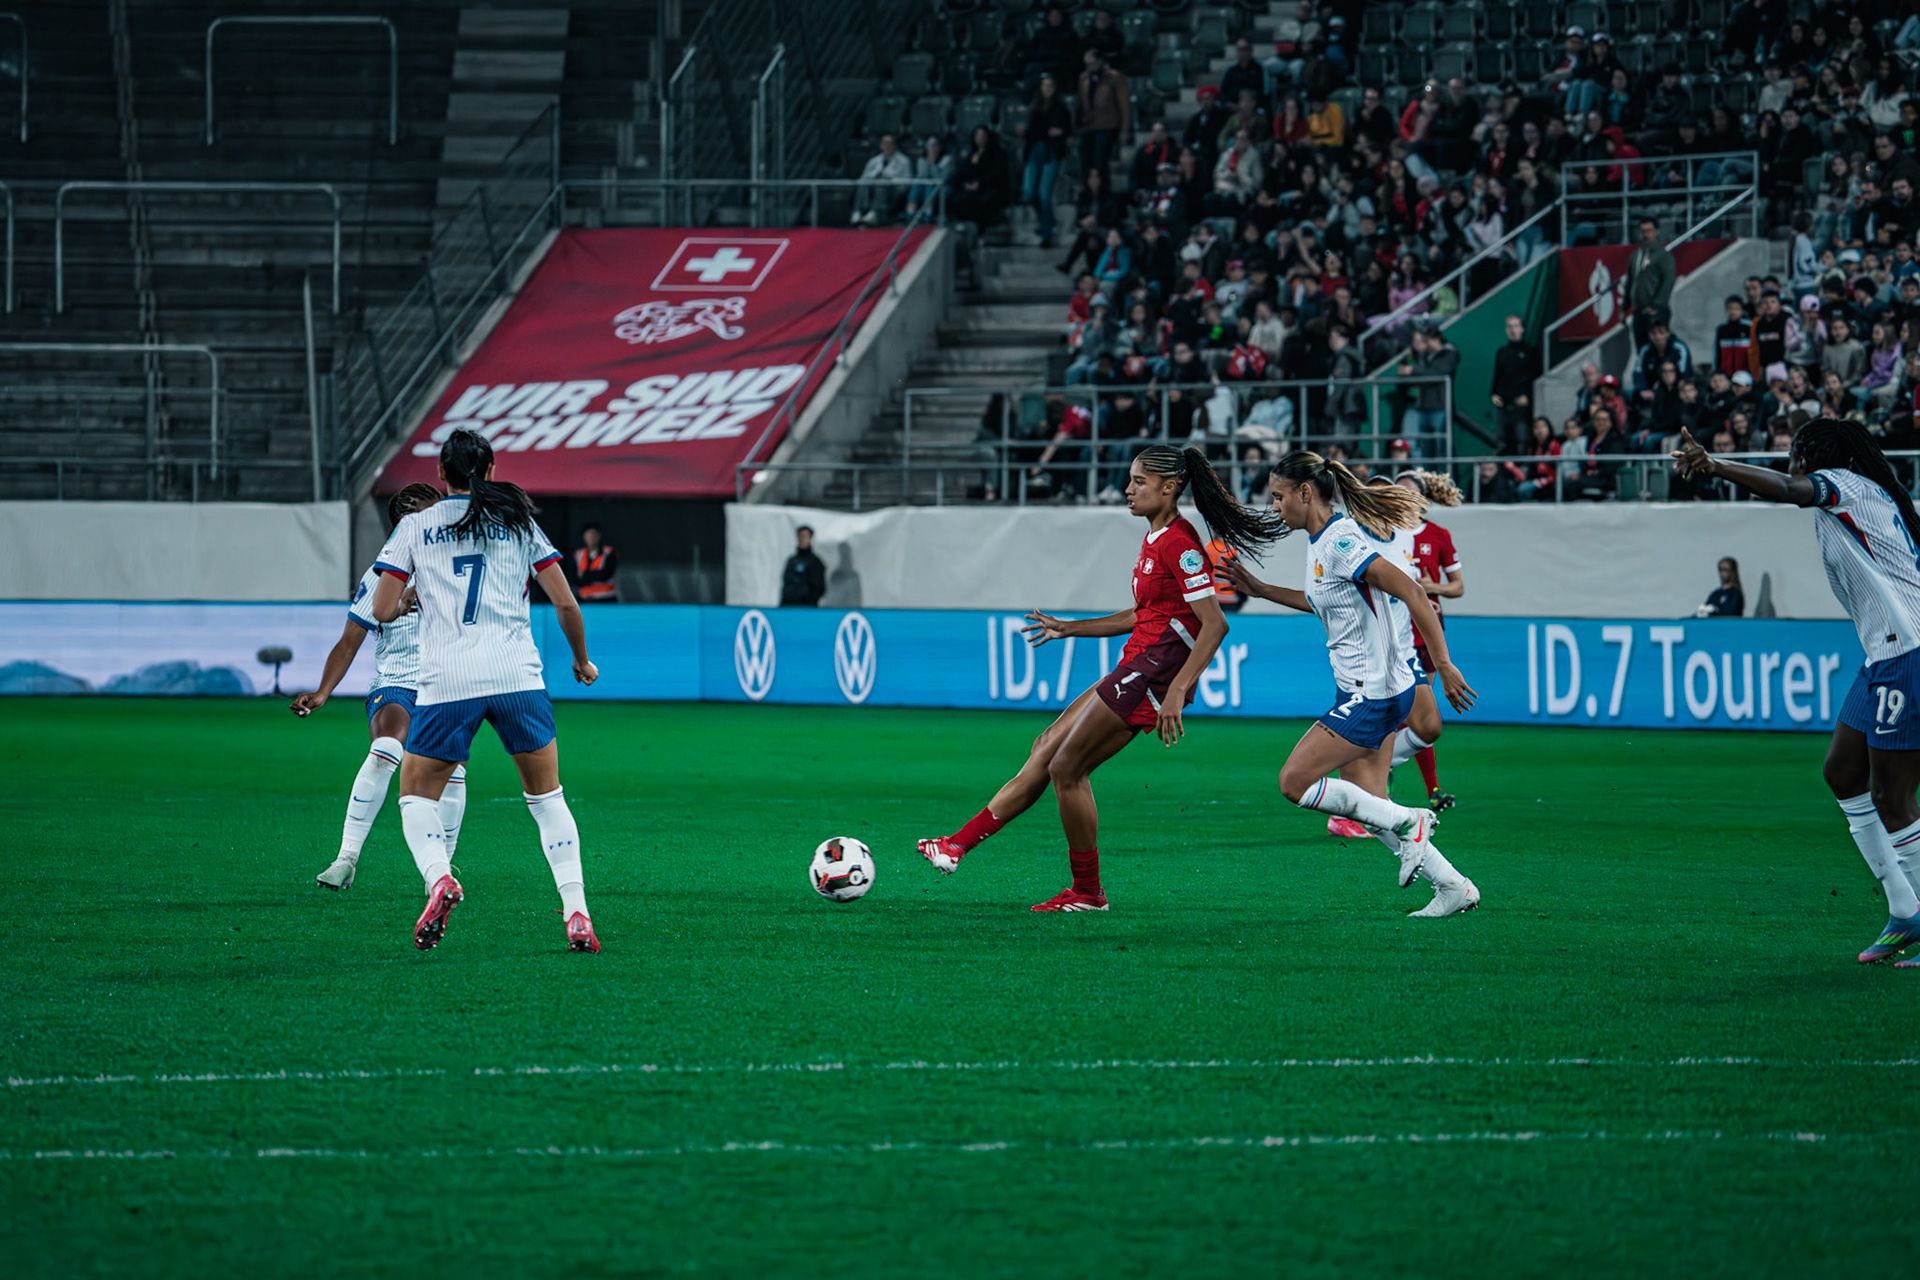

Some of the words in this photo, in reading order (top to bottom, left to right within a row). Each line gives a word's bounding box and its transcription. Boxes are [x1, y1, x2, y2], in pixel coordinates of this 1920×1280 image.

[443, 379, 609, 420] WIR
[608, 364, 806, 413] SIND
[412, 401, 777, 457] SCHWEIZ
[453, 553, 486, 626] 7
[1527, 623, 1633, 718] ID.7
[1650, 625, 1840, 722] Tourer
[1338, 693, 1364, 717] 2
[1876, 685, 1905, 725] 19
